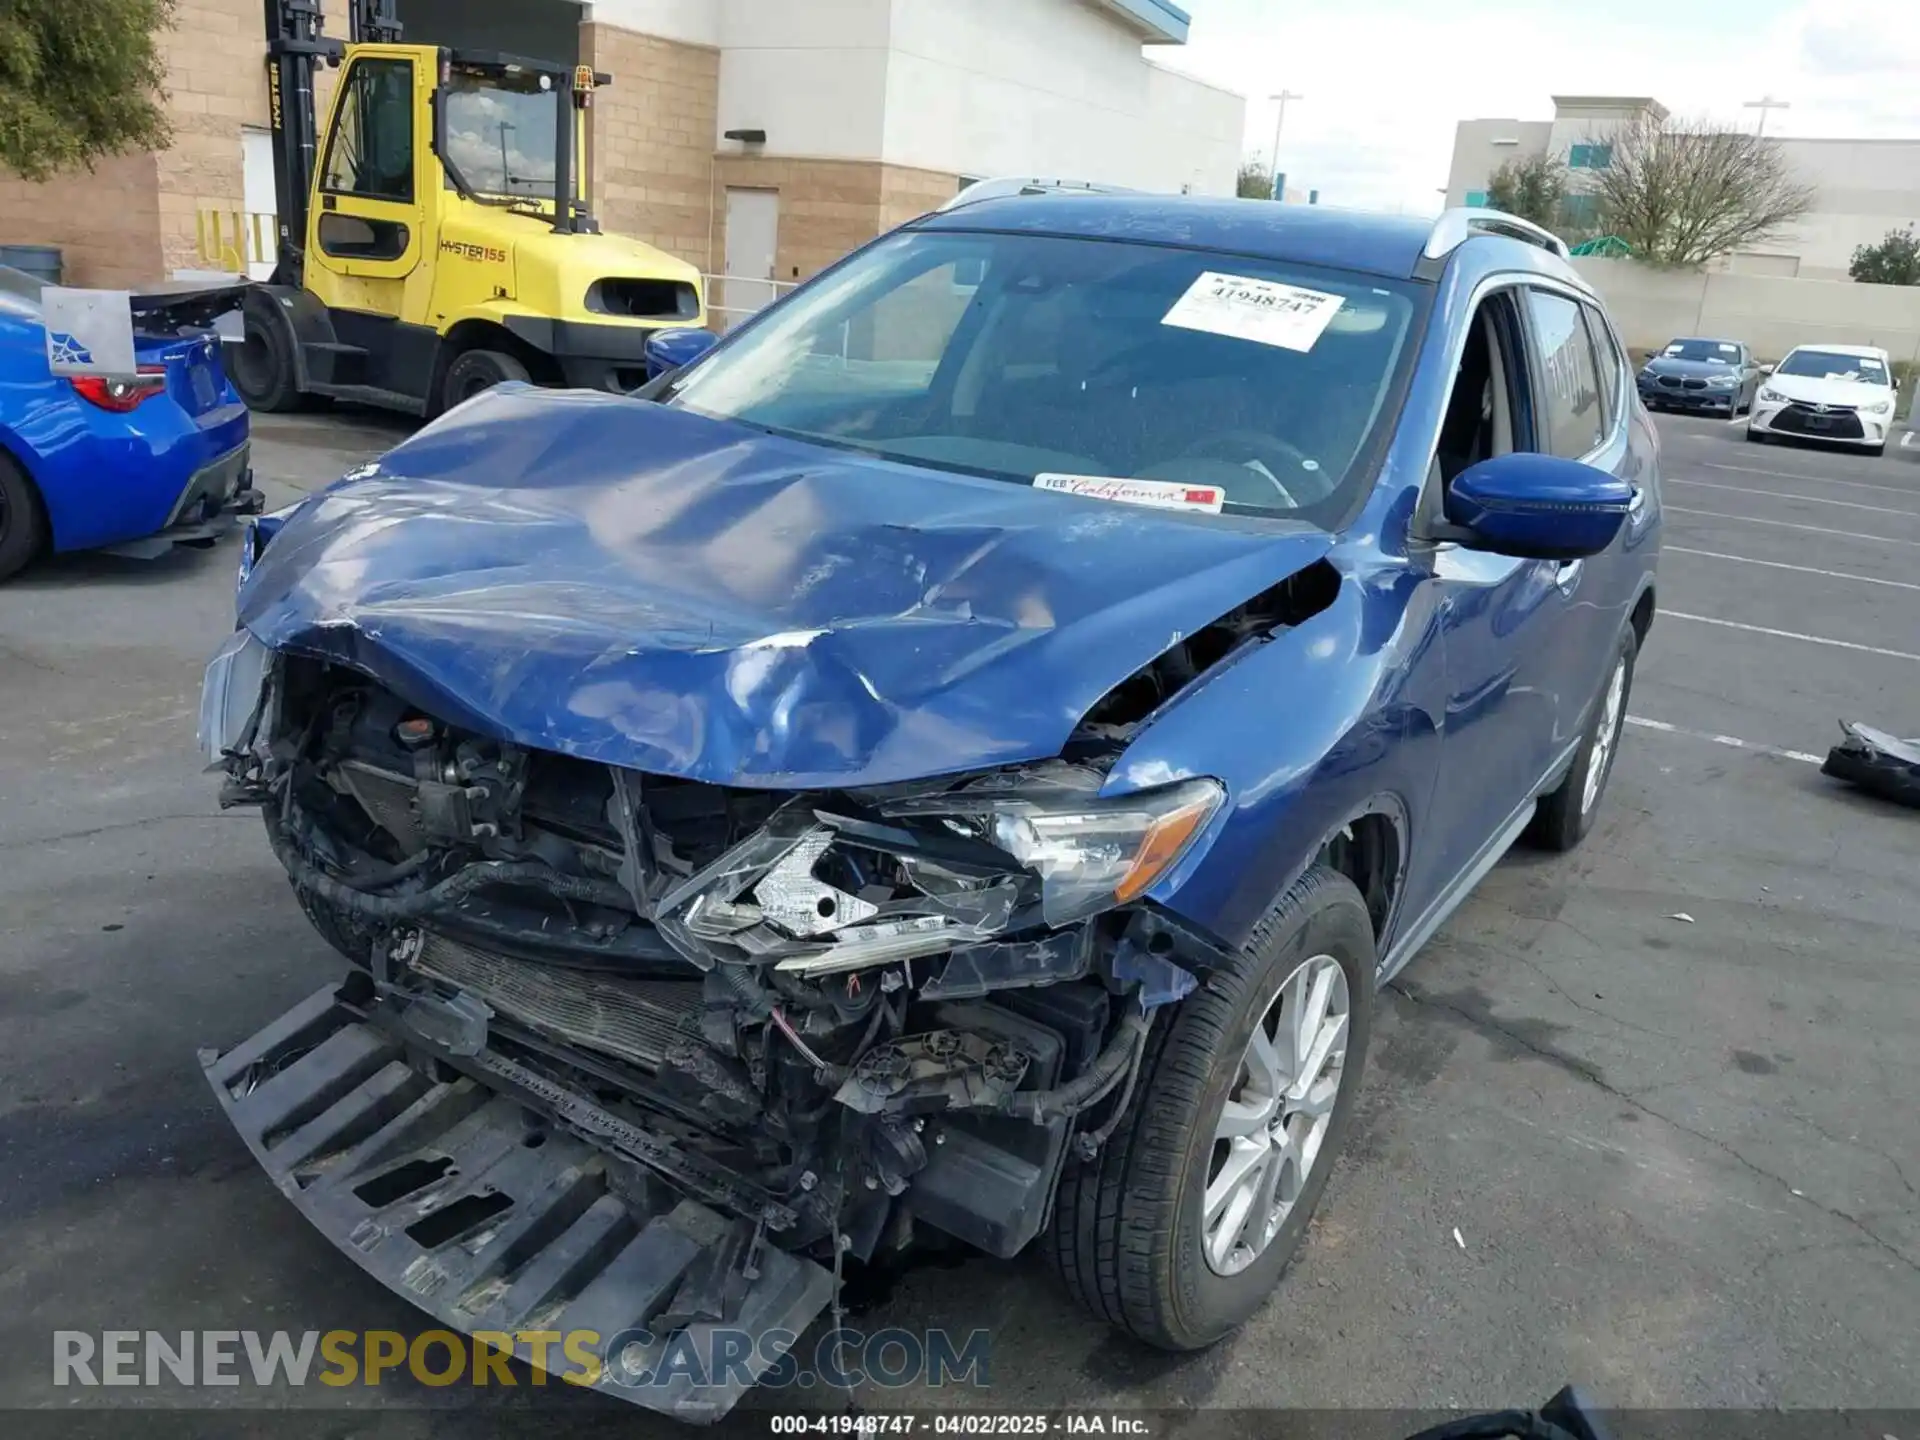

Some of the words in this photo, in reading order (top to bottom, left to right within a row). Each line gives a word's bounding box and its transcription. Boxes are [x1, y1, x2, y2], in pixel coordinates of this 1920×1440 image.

[270, 62, 281, 129] HYSTER
[440, 239, 484, 258] HYSTER
[484, 247, 507, 263] 155
[1211, 286, 1319, 315] 41948747
[1046, 479, 1067, 488] FEB
[1072, 478, 1177, 501] California
